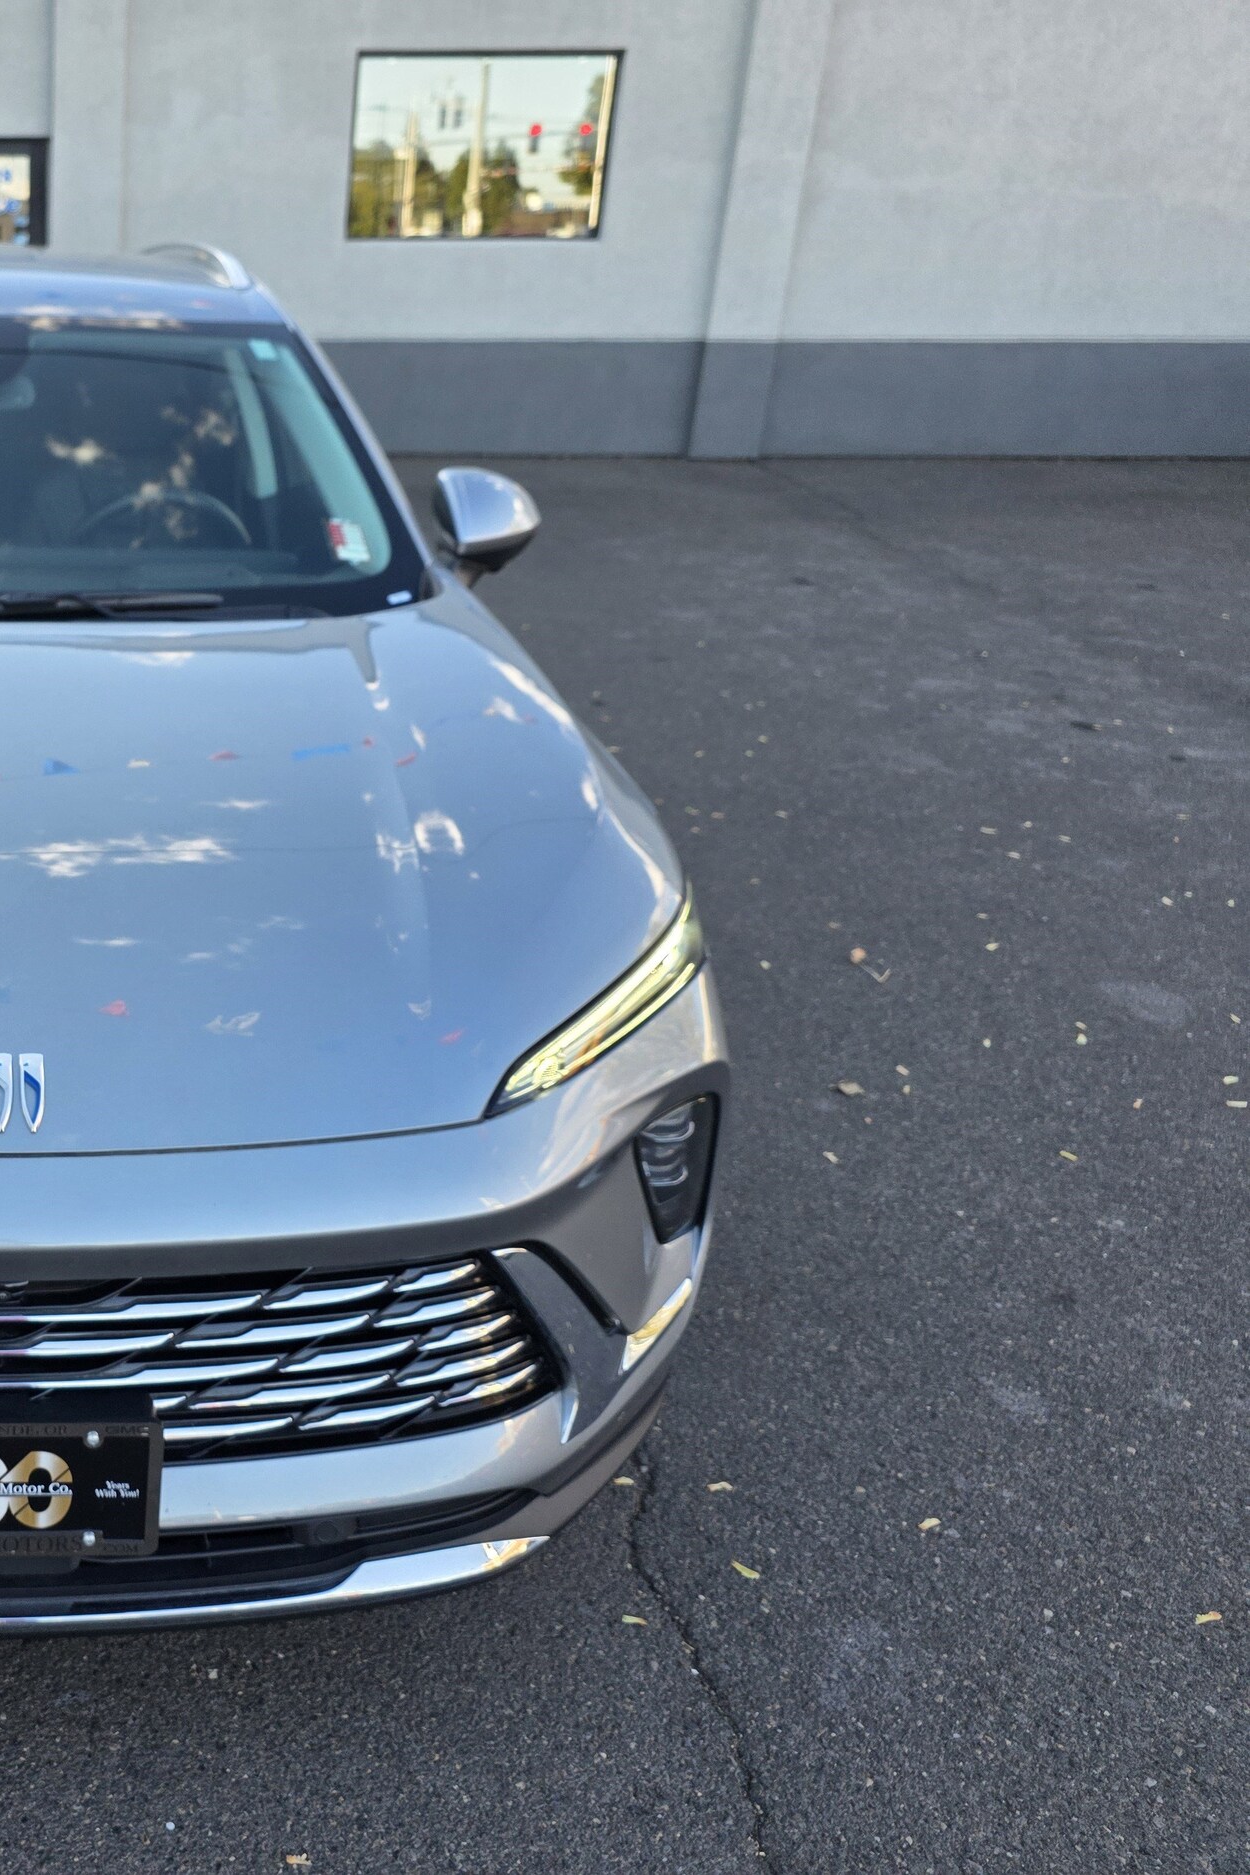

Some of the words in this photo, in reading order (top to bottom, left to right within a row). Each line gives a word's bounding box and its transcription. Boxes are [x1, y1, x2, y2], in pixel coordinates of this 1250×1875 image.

[104, 1425, 149, 1436] GMC
[0, 1482, 45, 1495] Motor
[49, 1482, 73, 1495] Co.
